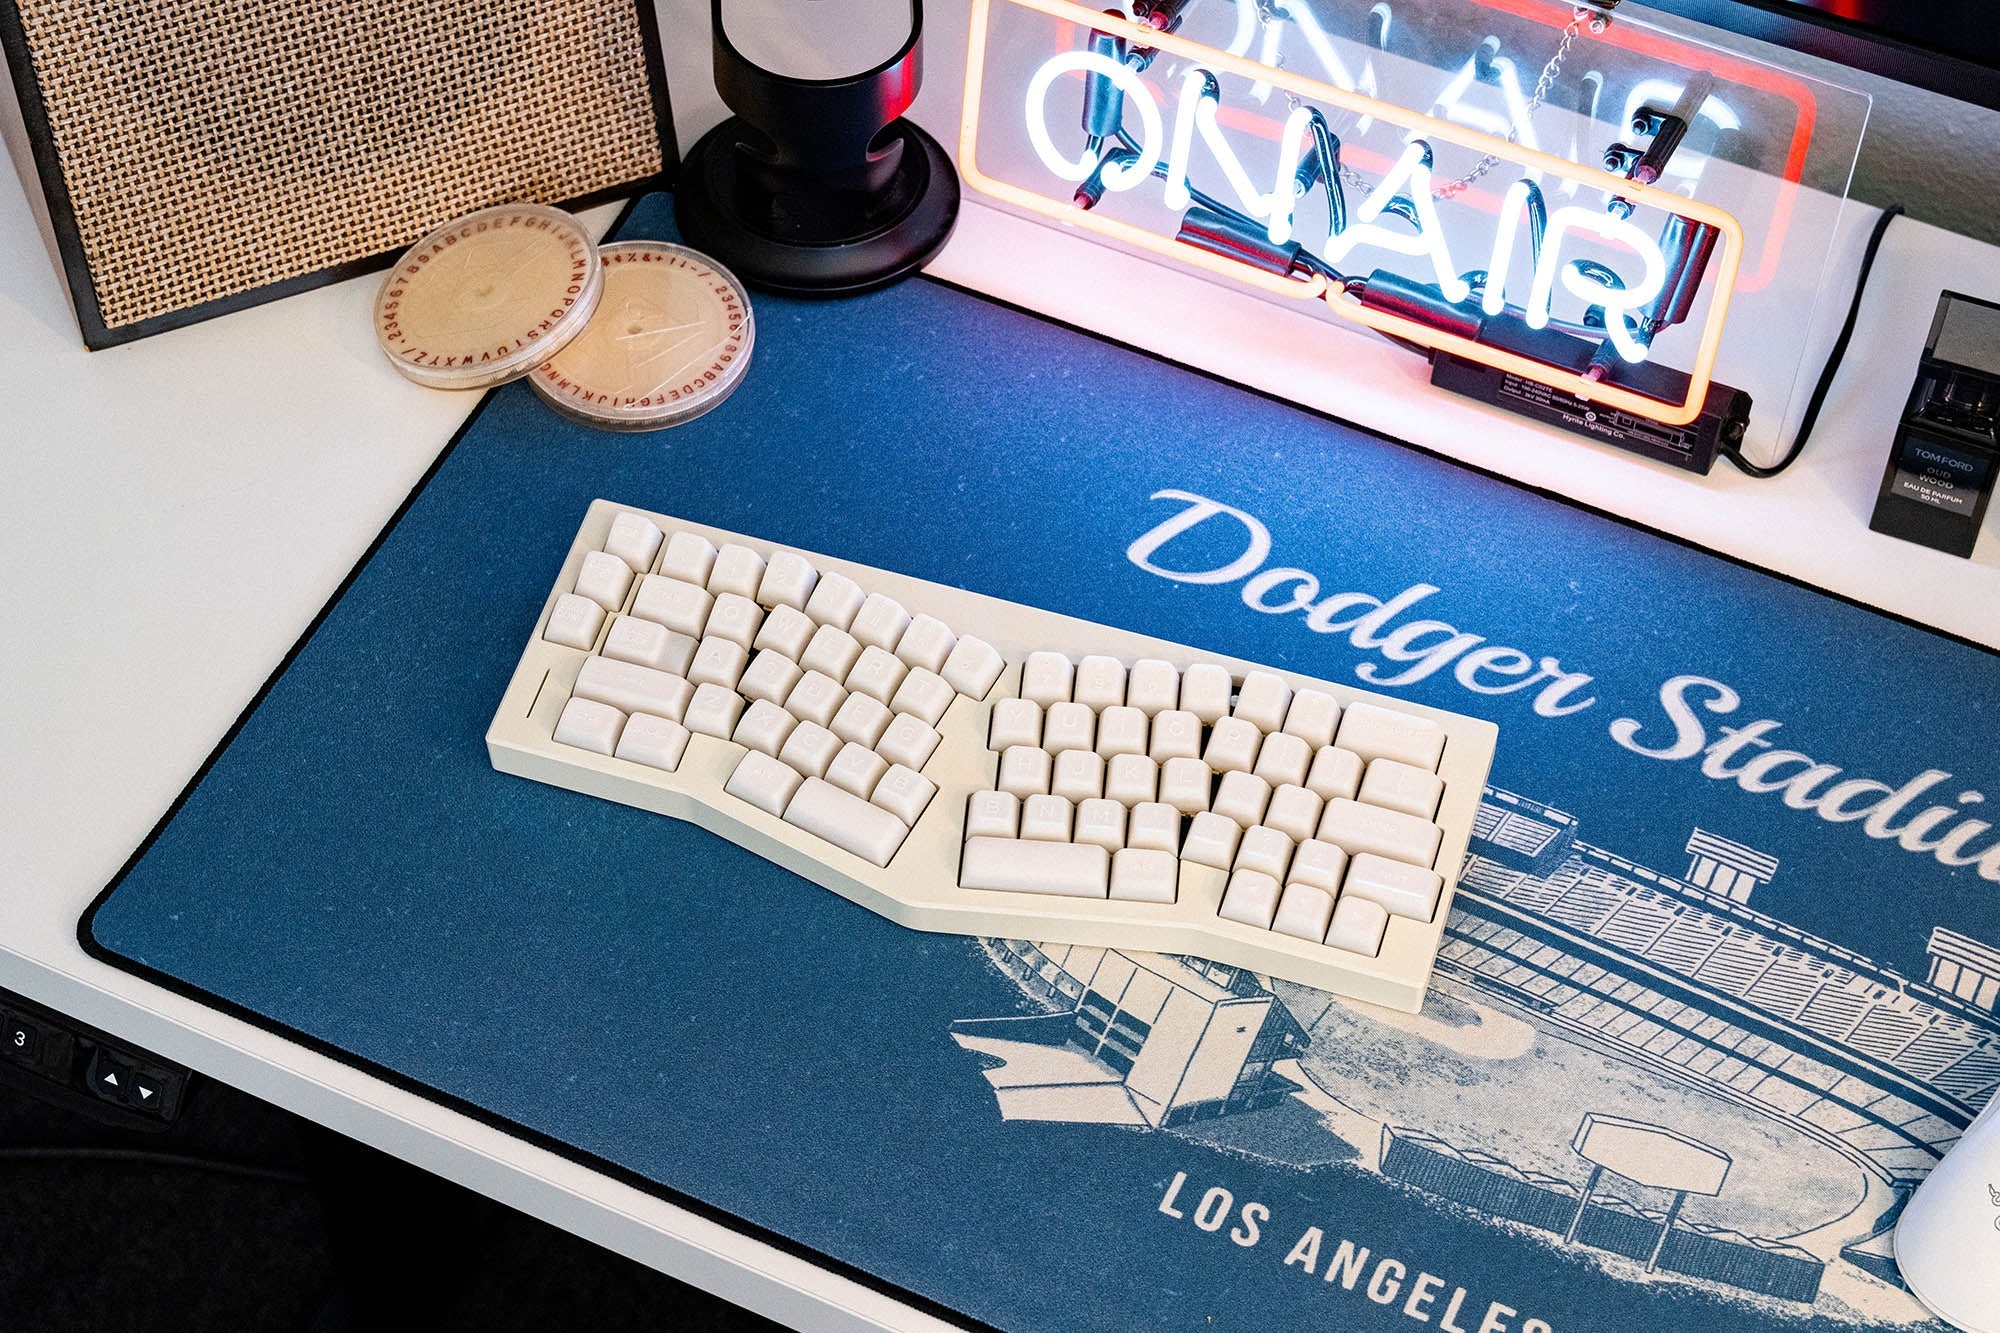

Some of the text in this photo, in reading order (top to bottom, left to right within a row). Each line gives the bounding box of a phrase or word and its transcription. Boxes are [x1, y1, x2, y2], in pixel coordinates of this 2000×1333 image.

[1025, 49, 1666, 364] ON AIR
[1584, 421, 1612, 436] Lighting
[1613, 430, 1625, 440] Co.
[1915, 447, 1974, 472] TOM FORD
[1903, 481, 1963, 504] EAU DE PARFUM
[1919, 474, 1954, 489] WOOD
[1126, 489, 1597, 718] Dodger
[14, 1030, 26, 1047] 3
[1158, 1171, 1271, 1248] LOS
